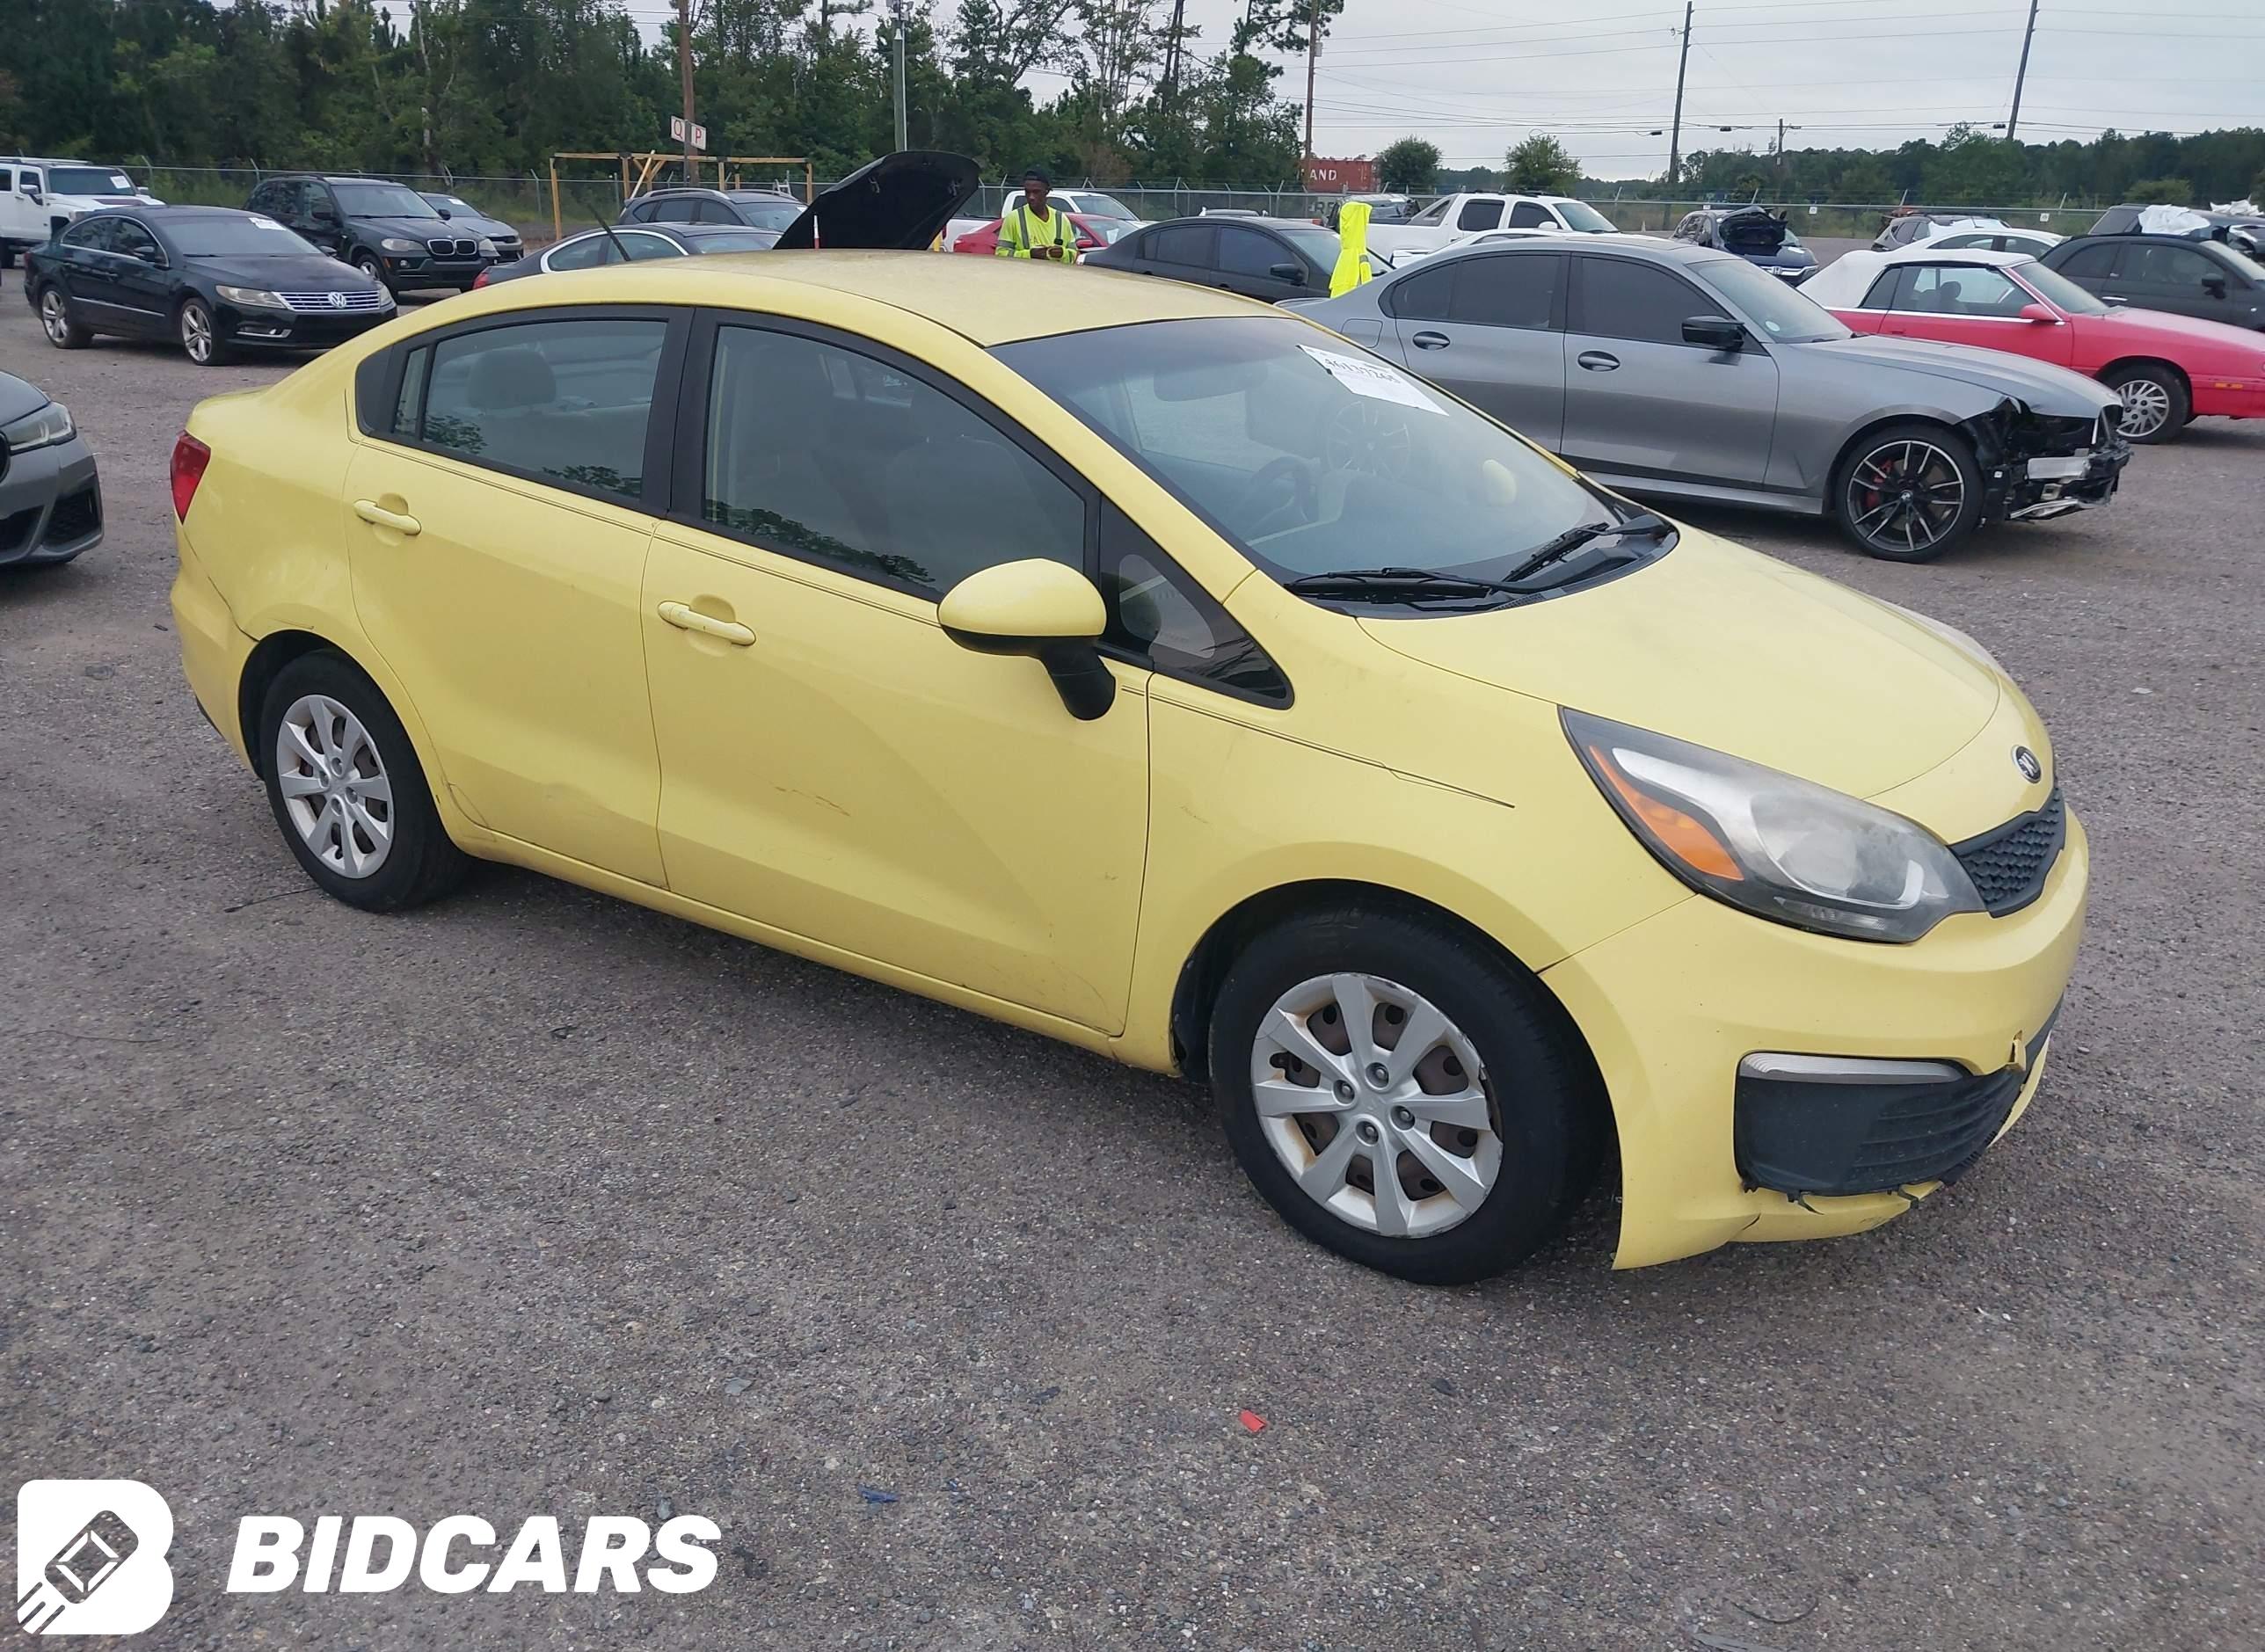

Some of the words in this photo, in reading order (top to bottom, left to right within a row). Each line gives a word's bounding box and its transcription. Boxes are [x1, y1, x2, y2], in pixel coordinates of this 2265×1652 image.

[674, 120, 683, 140] Q
[696, 127, 703, 144] P
[1301, 168, 1337, 181] AND
